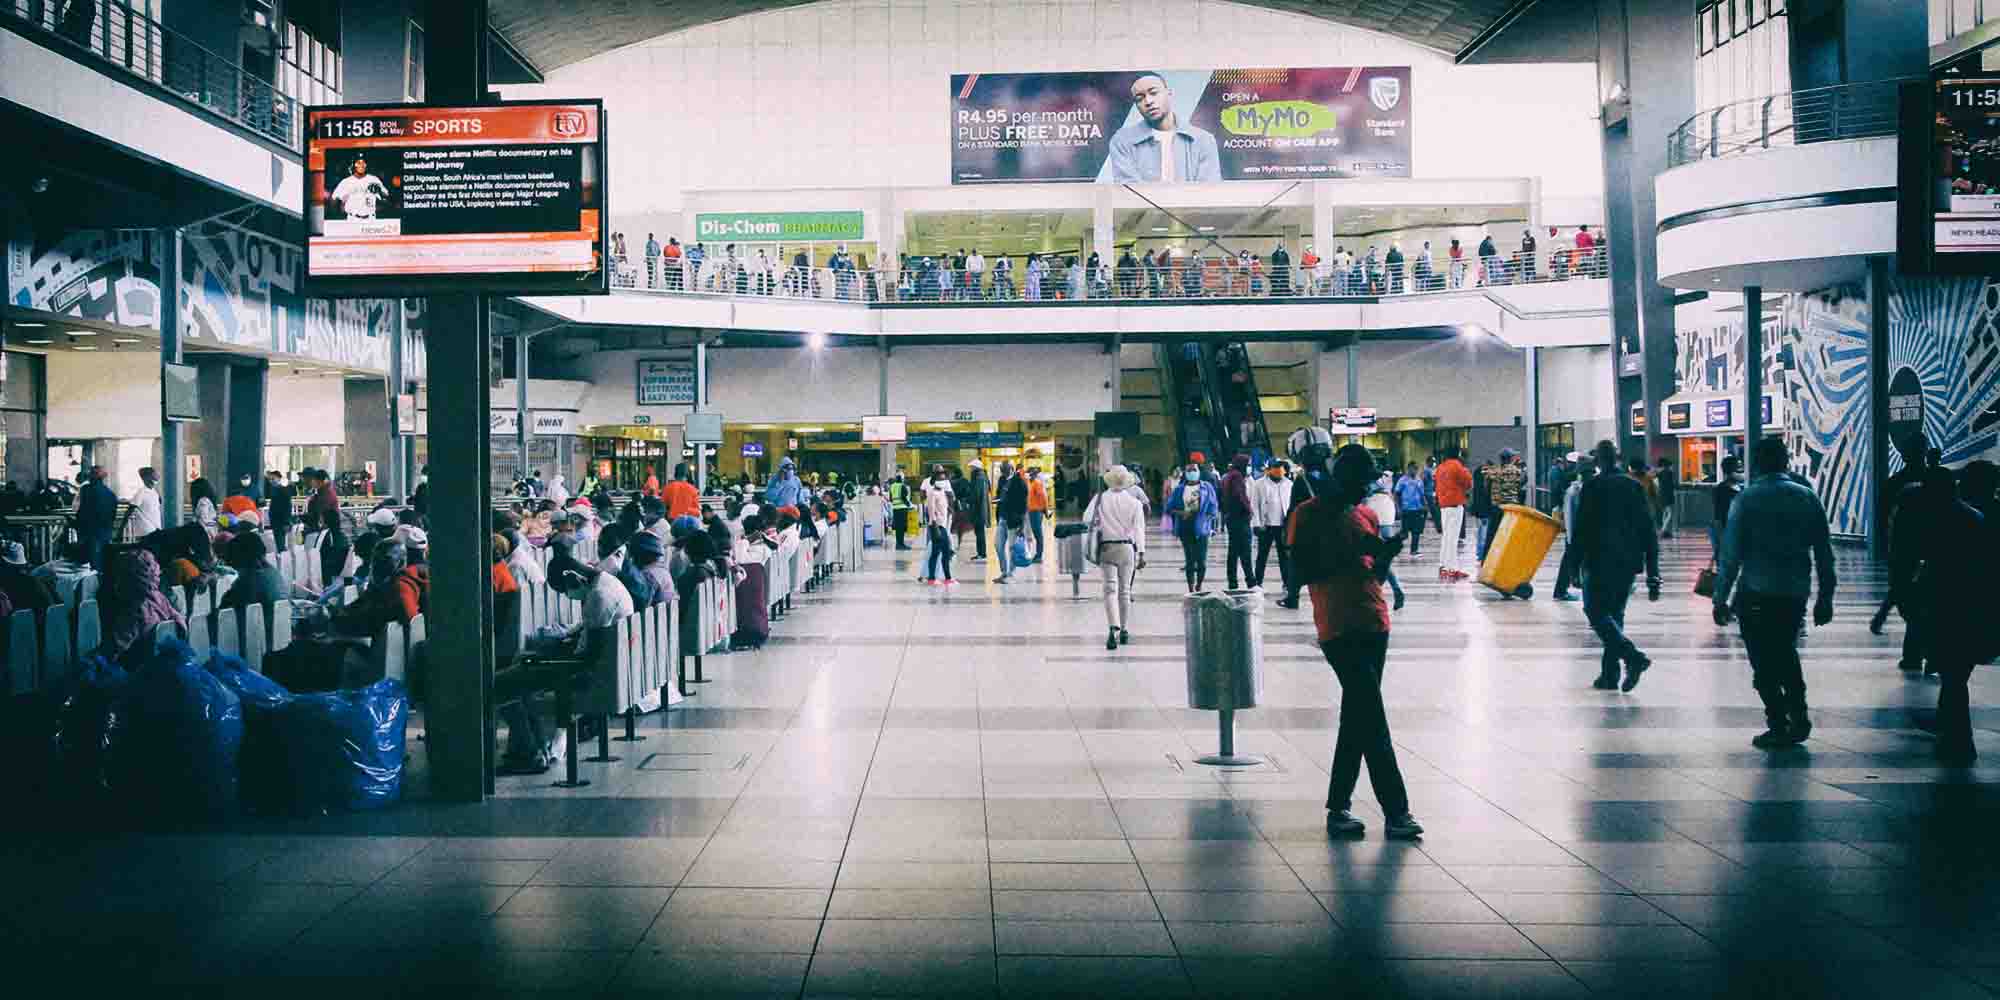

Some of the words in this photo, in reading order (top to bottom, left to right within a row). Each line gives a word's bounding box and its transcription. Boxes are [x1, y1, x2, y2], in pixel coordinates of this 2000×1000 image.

[1222, 93, 1251, 102] OPEN
[1252, 93, 1260, 101] A
[958, 109, 1007, 124] R4.95
[1011, 112, 1037, 127] per
[1040, 107, 1093, 122] month
[1237, 106, 1311, 132] MyMo
[323, 120, 374, 137] 11:58
[413, 118, 482, 135] SPORTS
[1366, 119, 1406, 129] Standard
[390, 127, 405, 137] May
[958, 127, 1001, 140] PLUS
[1058, 124, 1103, 139] DATA
[958, 141, 970, 149] ON
[977, 140, 1019, 149] STANDARD
[1223, 138, 1273, 149] ACCOUNT
[1273, 138, 1292, 148] ON
[1318, 137, 1340, 147] APP
[498, 148, 547, 158] documentary
[560, 147, 573, 156] his
[403, 161, 435, 169] baseball
[435, 161, 465, 170] journey
[527, 172, 554, 180] baseball
[494, 182, 535, 190] documentary
[413, 193, 437, 201] journey
[502, 191, 515, 199] play
[516, 190, 534, 198] Major
[535, 190, 559, 199] League
[403, 201, 430, 209] Baseball
[466, 200, 495, 208] imploring
[521, 199, 532, 207] not
[700, 219, 780, 235] Dis-Chem
[783, 222, 859, 234] PHARMACY
[536, 417, 564, 428] AWAY
